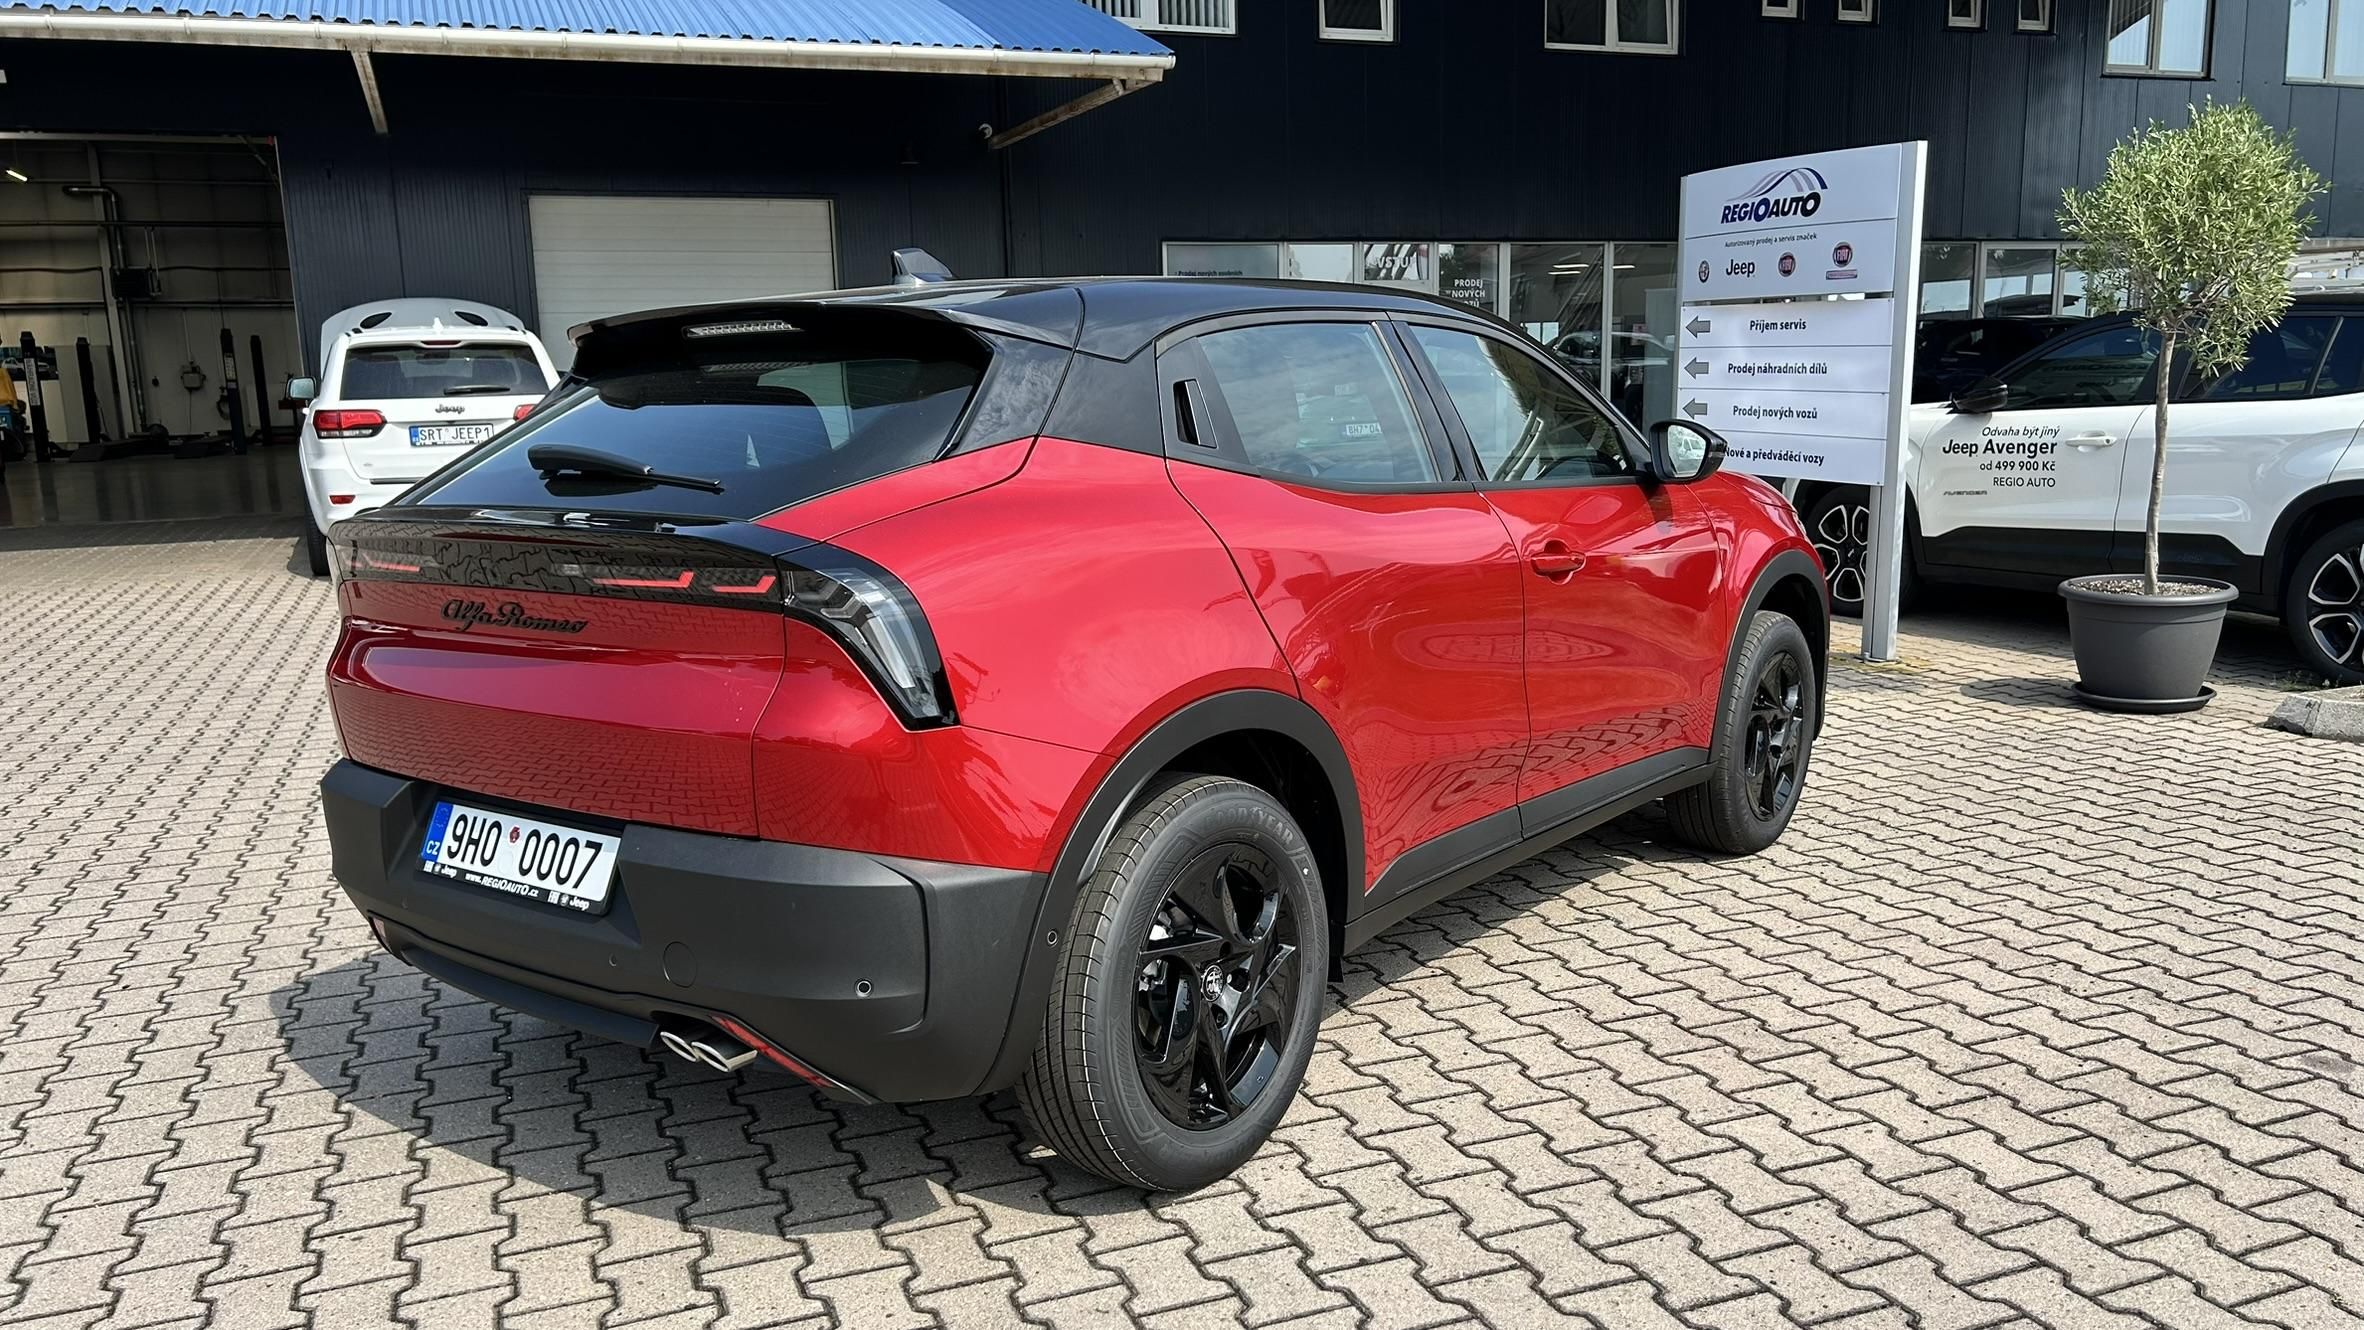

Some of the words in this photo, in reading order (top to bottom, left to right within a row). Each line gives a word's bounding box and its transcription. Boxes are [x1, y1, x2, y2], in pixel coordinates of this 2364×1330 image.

[1720, 191, 1821, 224] REGIOAUTO
[1724, 238, 1755, 248] Autorizovaný
[1756, 236, 1773, 246] prodej
[1778, 234, 1795, 243] servis
[1796, 232, 1817, 241] značek
[1725, 258, 1756, 278] Jeep
[1454, 279, 1483, 289] PRODEJ
[1451, 288, 1486, 298] NOVÝCH
[1749, 318, 1778, 332] Příjem
[1779, 318, 1807, 331] servis
[1727, 363, 1756, 377] Prodej
[1757, 362, 1807, 375] náhradních
[1809, 362, 1828, 375] dílů
[434, 404, 466, 414] Jeep
[1732, 405, 1763, 417] Prodej
[1762, 406, 1794, 420] nových
[1795, 407, 1818, 419] vozů
[419, 428, 443, 441] SRT
[451, 427, 490, 440] JEEP1
[1981, 426, 2020, 437] Odvaha
[2022, 426, 2039, 438] být
[2038, 426, 2061, 438] jiný
[1942, 438, 1979, 457] Jeep
[1983, 439, 2058, 459] Avenger
[1725, 447, 1745, 458] Nové
[1746, 450, 1751, 458] a
[1752, 448, 1801, 463] předváděcí
[1802, 453, 1825, 467] vozy
[1979, 461, 1993, 471] od
[1995, 461, 2015, 471] 499
[2018, 461, 2039, 471] 900
[2041, 460, 2056, 471] Kč
[1993, 477, 2025, 487] REGIO
[2026, 477, 2056, 488] AUTO
[441, 599, 495, 632] Alfa
[497, 601, 589, 634] Romeo
[426, 840, 441, 856] CZ
[446, 813, 503, 867] 9H0
[518, 829, 604, 889] 0007
[440, 865, 457, 879] Jeep
[465, 872, 539, 898] www.REGIOAUTO.cz
[569, 896, 590, 911] Jeep
